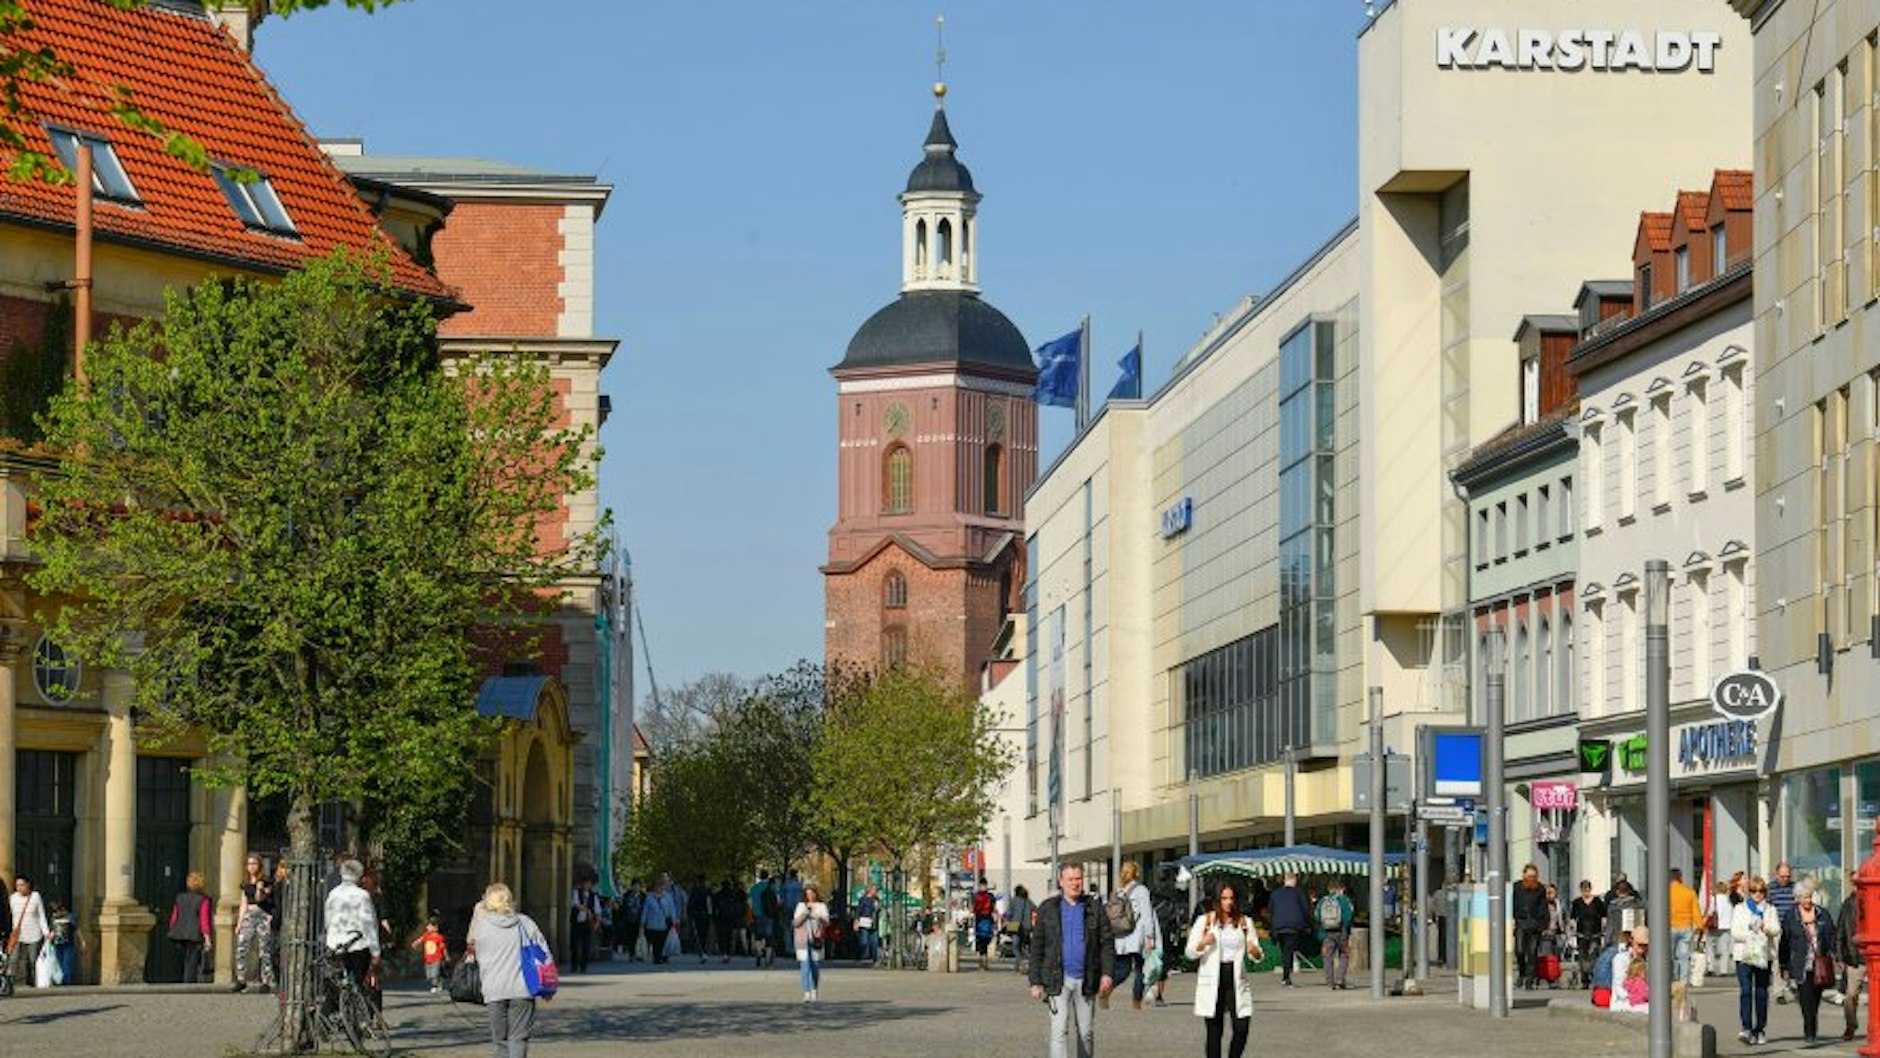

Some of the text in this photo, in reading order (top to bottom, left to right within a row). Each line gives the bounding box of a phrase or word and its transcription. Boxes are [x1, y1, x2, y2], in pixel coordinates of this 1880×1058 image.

[1436, 28, 1722, 73] KARSTADT
[1722, 682, 1768, 707] C&A
[1679, 720, 1756, 763] APOTHEKE
